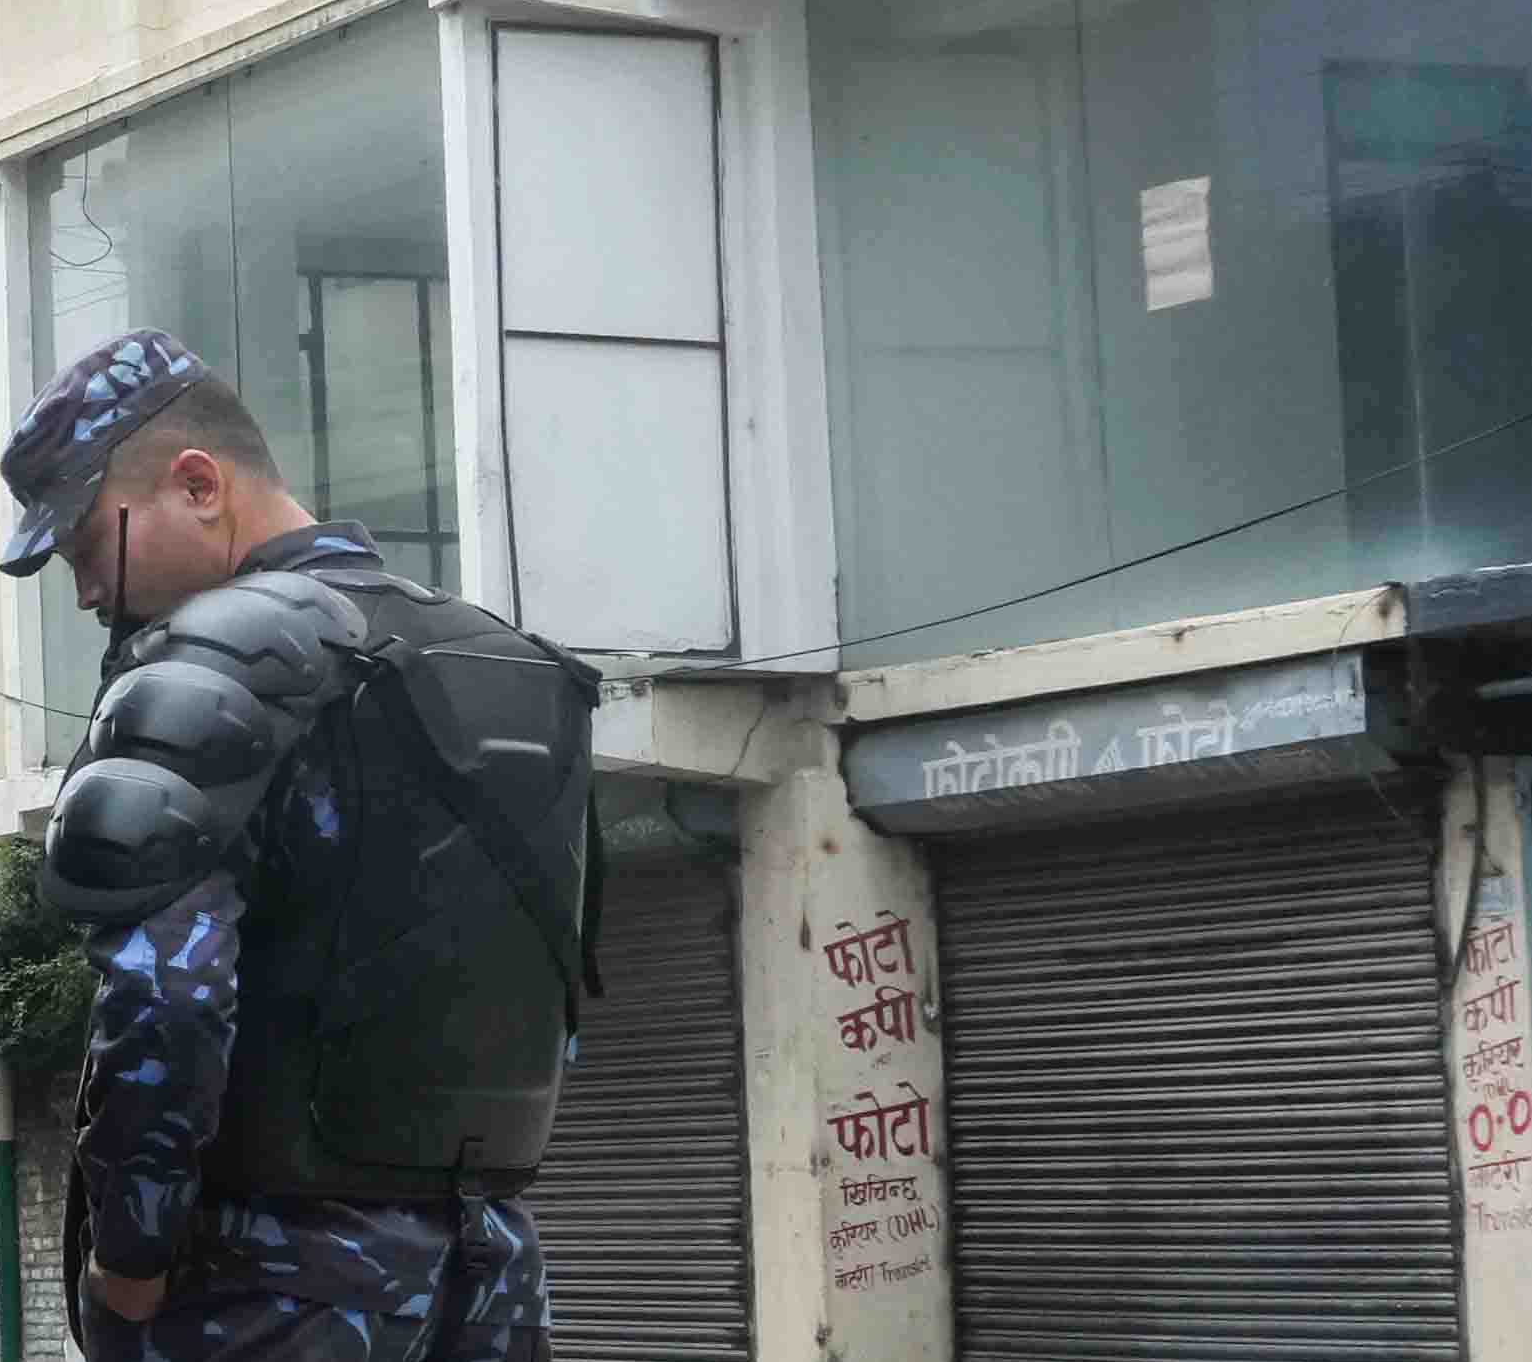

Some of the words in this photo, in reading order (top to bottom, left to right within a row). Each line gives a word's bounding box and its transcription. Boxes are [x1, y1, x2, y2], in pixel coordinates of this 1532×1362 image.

[823, 909, 916, 988] फोटो
[836, 986, 916, 1052] कपी
[827, 1081, 929, 1161] फोटो
